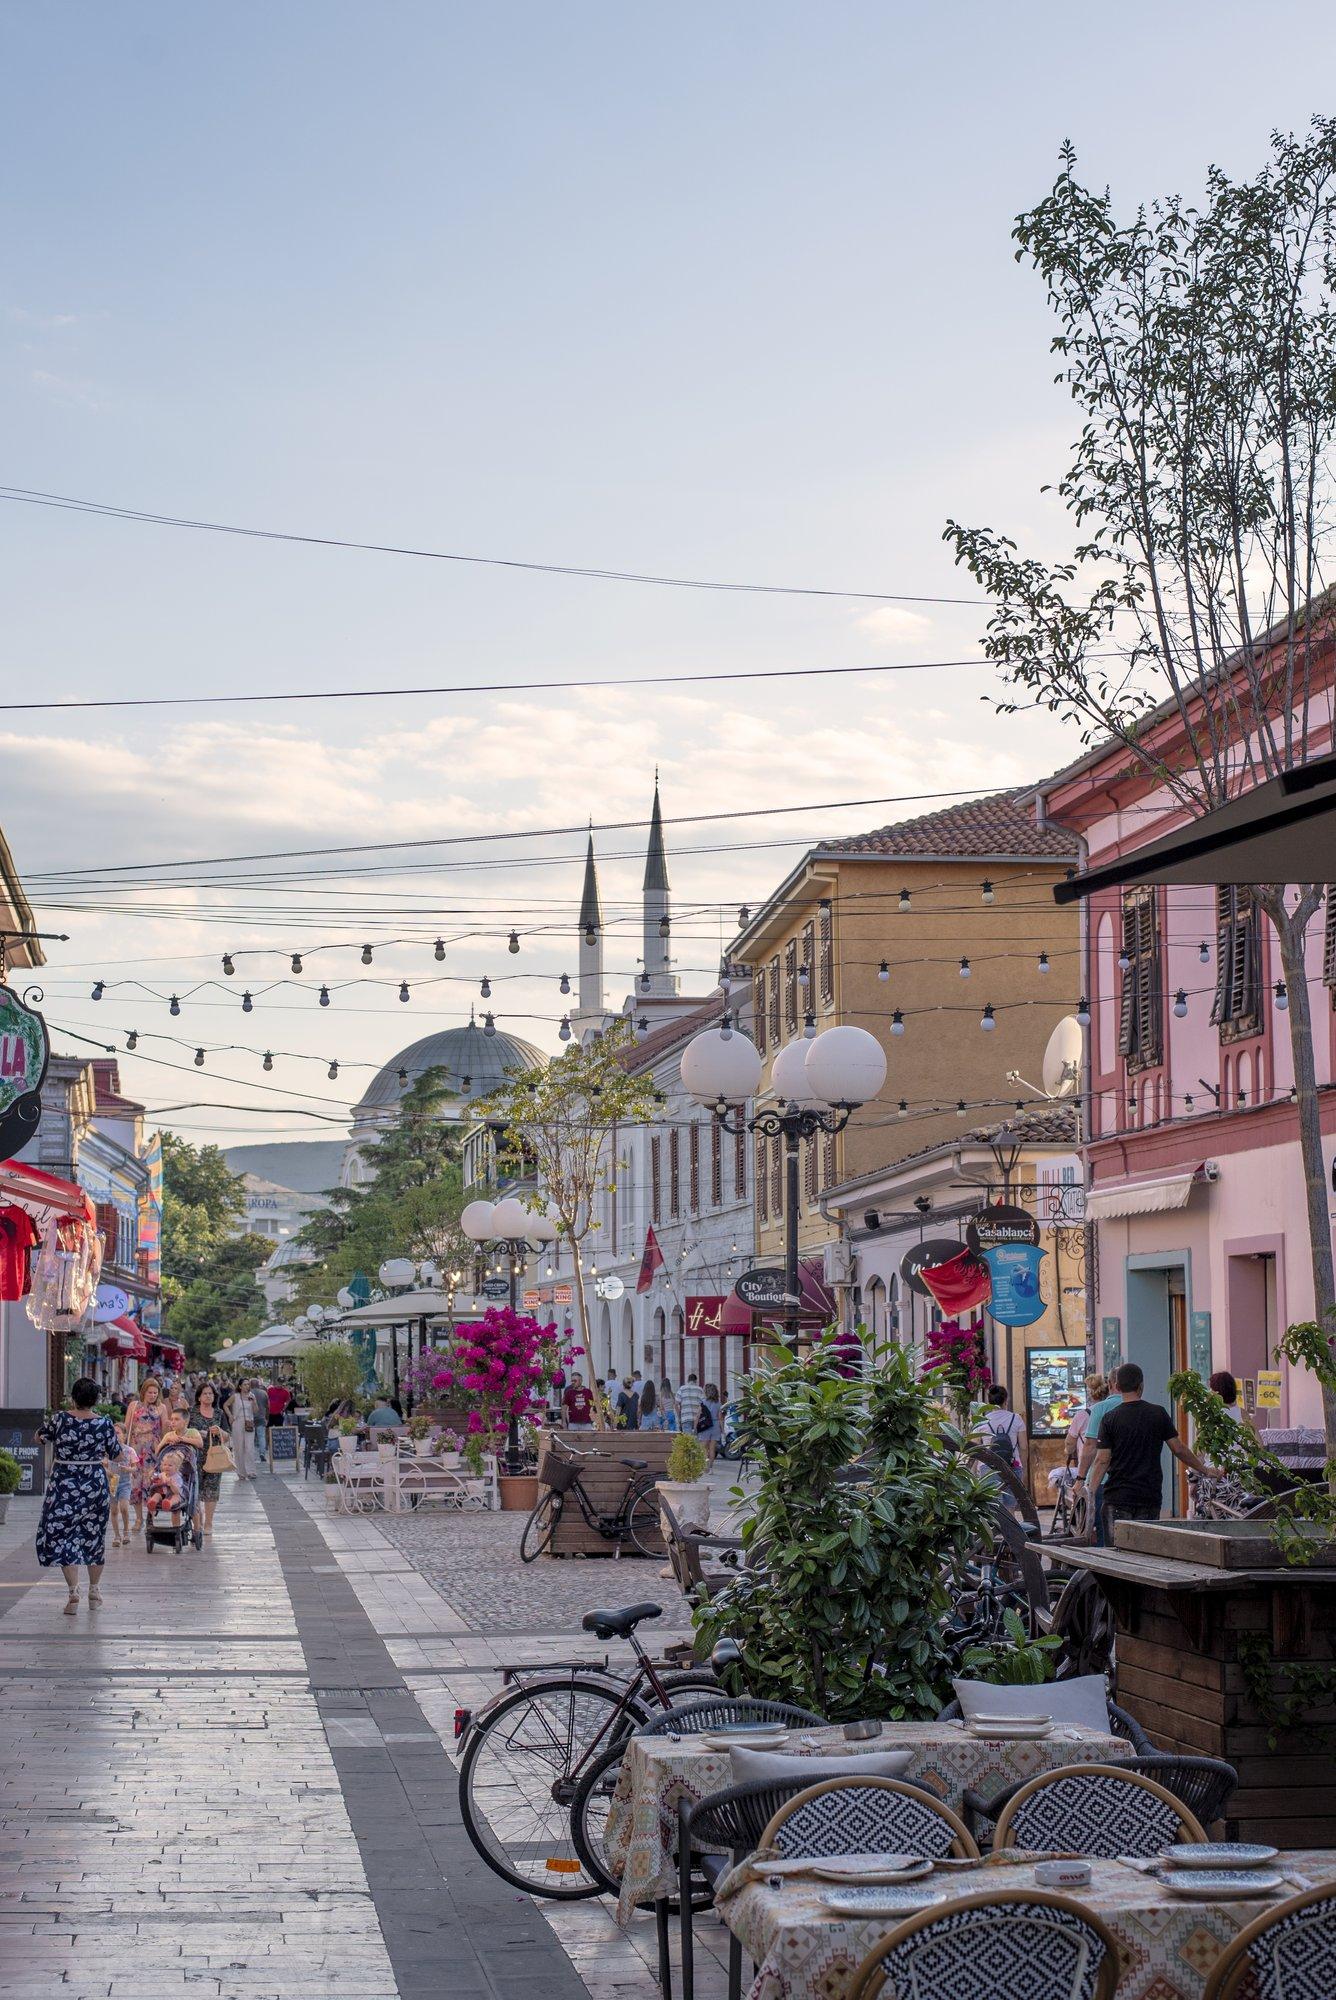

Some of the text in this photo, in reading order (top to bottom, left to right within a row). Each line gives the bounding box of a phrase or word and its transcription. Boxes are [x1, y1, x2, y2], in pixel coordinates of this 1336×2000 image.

[977, 1227, 1035, 1238] Casablanca
[741, 1281, 763, 1293] City
[745, 1292, 785, 1303] Boutiqu
[19, 1447, 39, 1455] PHONE
